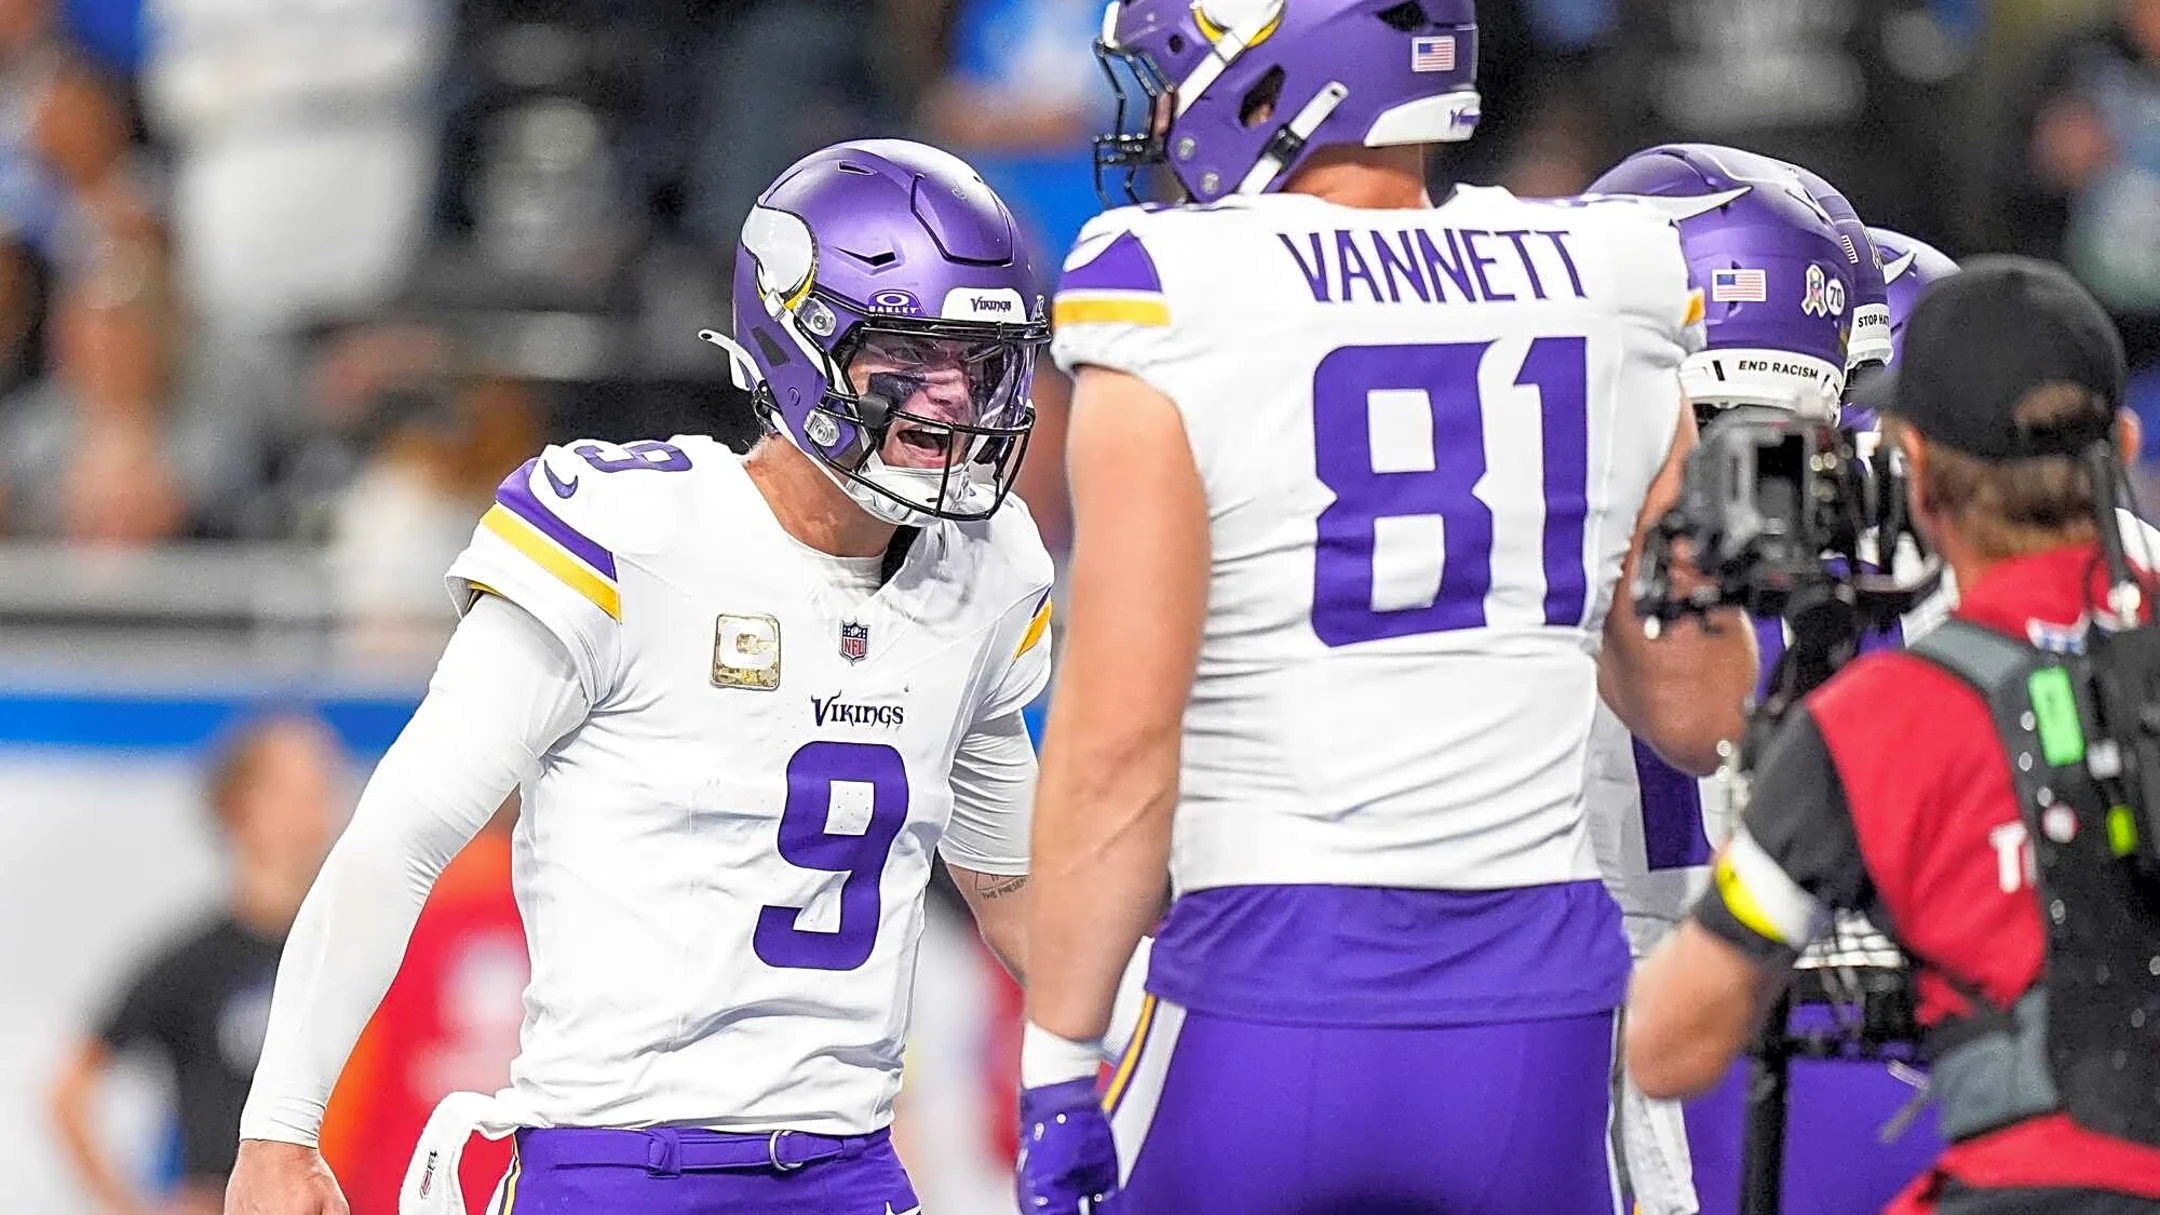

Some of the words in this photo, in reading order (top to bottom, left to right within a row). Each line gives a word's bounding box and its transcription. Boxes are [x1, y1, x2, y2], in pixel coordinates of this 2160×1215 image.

[1276, 229, 1588, 303] VANNETT
[1830, 286, 1843, 309] 70
[868, 305, 917, 314] OAKLEY
[1858, 313, 1878, 328] STOP
[1738, 359, 1768, 371] END
[1772, 361, 1819, 379] RACISM
[1311, 336, 1588, 647] 81
[844, 638, 867, 657] NFL
[753, 740, 910, 971] 9
